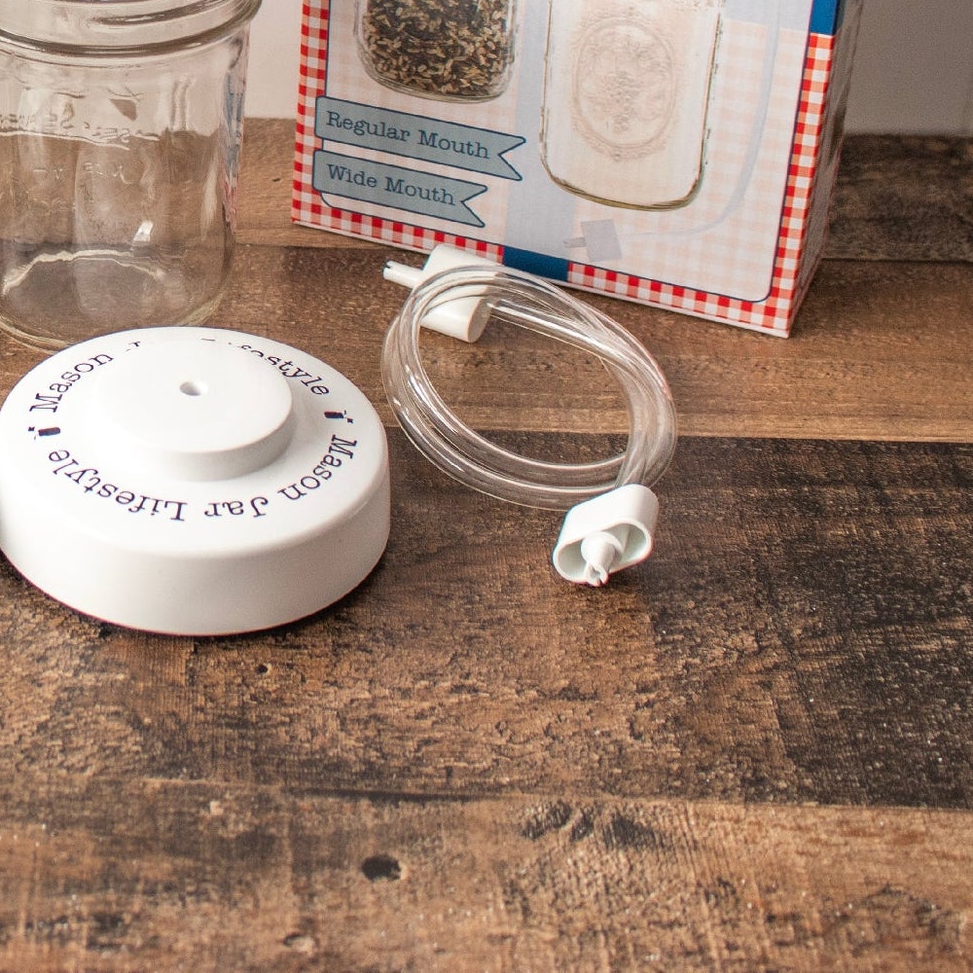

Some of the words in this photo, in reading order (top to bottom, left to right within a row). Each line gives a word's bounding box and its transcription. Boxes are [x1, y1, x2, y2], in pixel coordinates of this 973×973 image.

[326, 110, 411, 143] Regular
[418, 129, 490, 159] Mouth
[327, 163, 377, 188] Wide
[384, 177, 456, 206] Mouth
[29, 352, 114, 413] Mason
[48, 449, 188, 521] Lifestyle
[277, 434, 357, 500] Mason
[204, 496, 269, 518] Jar
